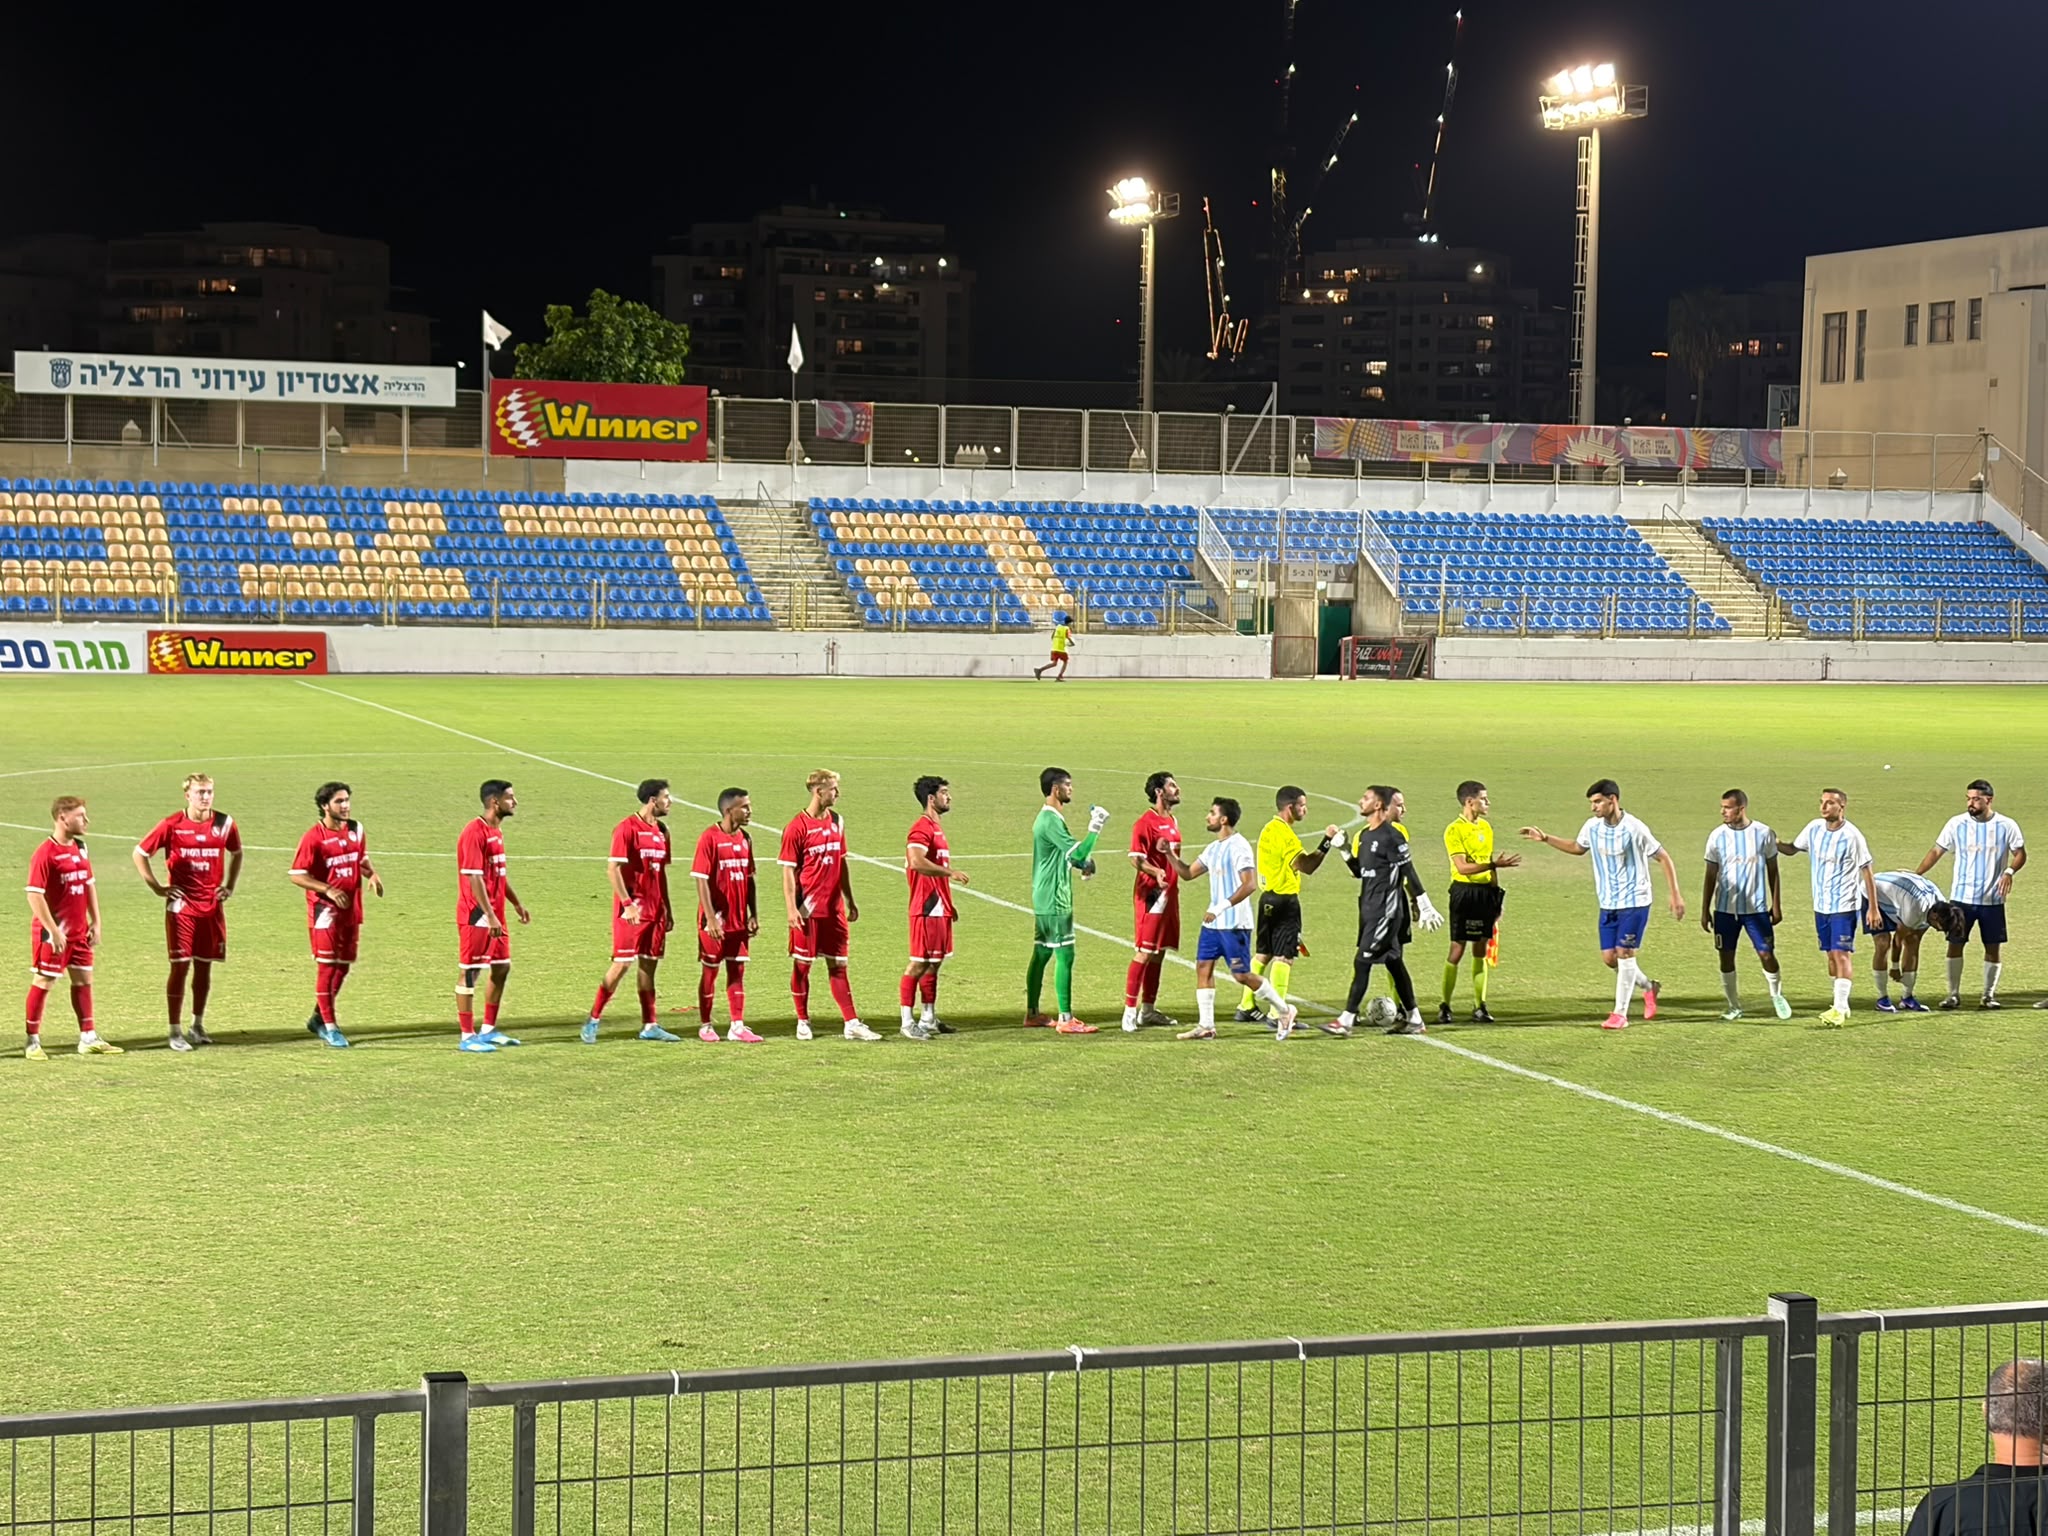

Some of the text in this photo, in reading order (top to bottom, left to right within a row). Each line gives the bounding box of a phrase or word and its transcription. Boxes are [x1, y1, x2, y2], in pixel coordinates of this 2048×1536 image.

[80, 360, 379, 396] אצטדיון עירוני הרצליה
[383, 380, 425, 392] הרצליה
[543, 401, 699, 441] Winner
[53, 639, 130, 670] מגה
[184, 638, 313, 668] Winner
